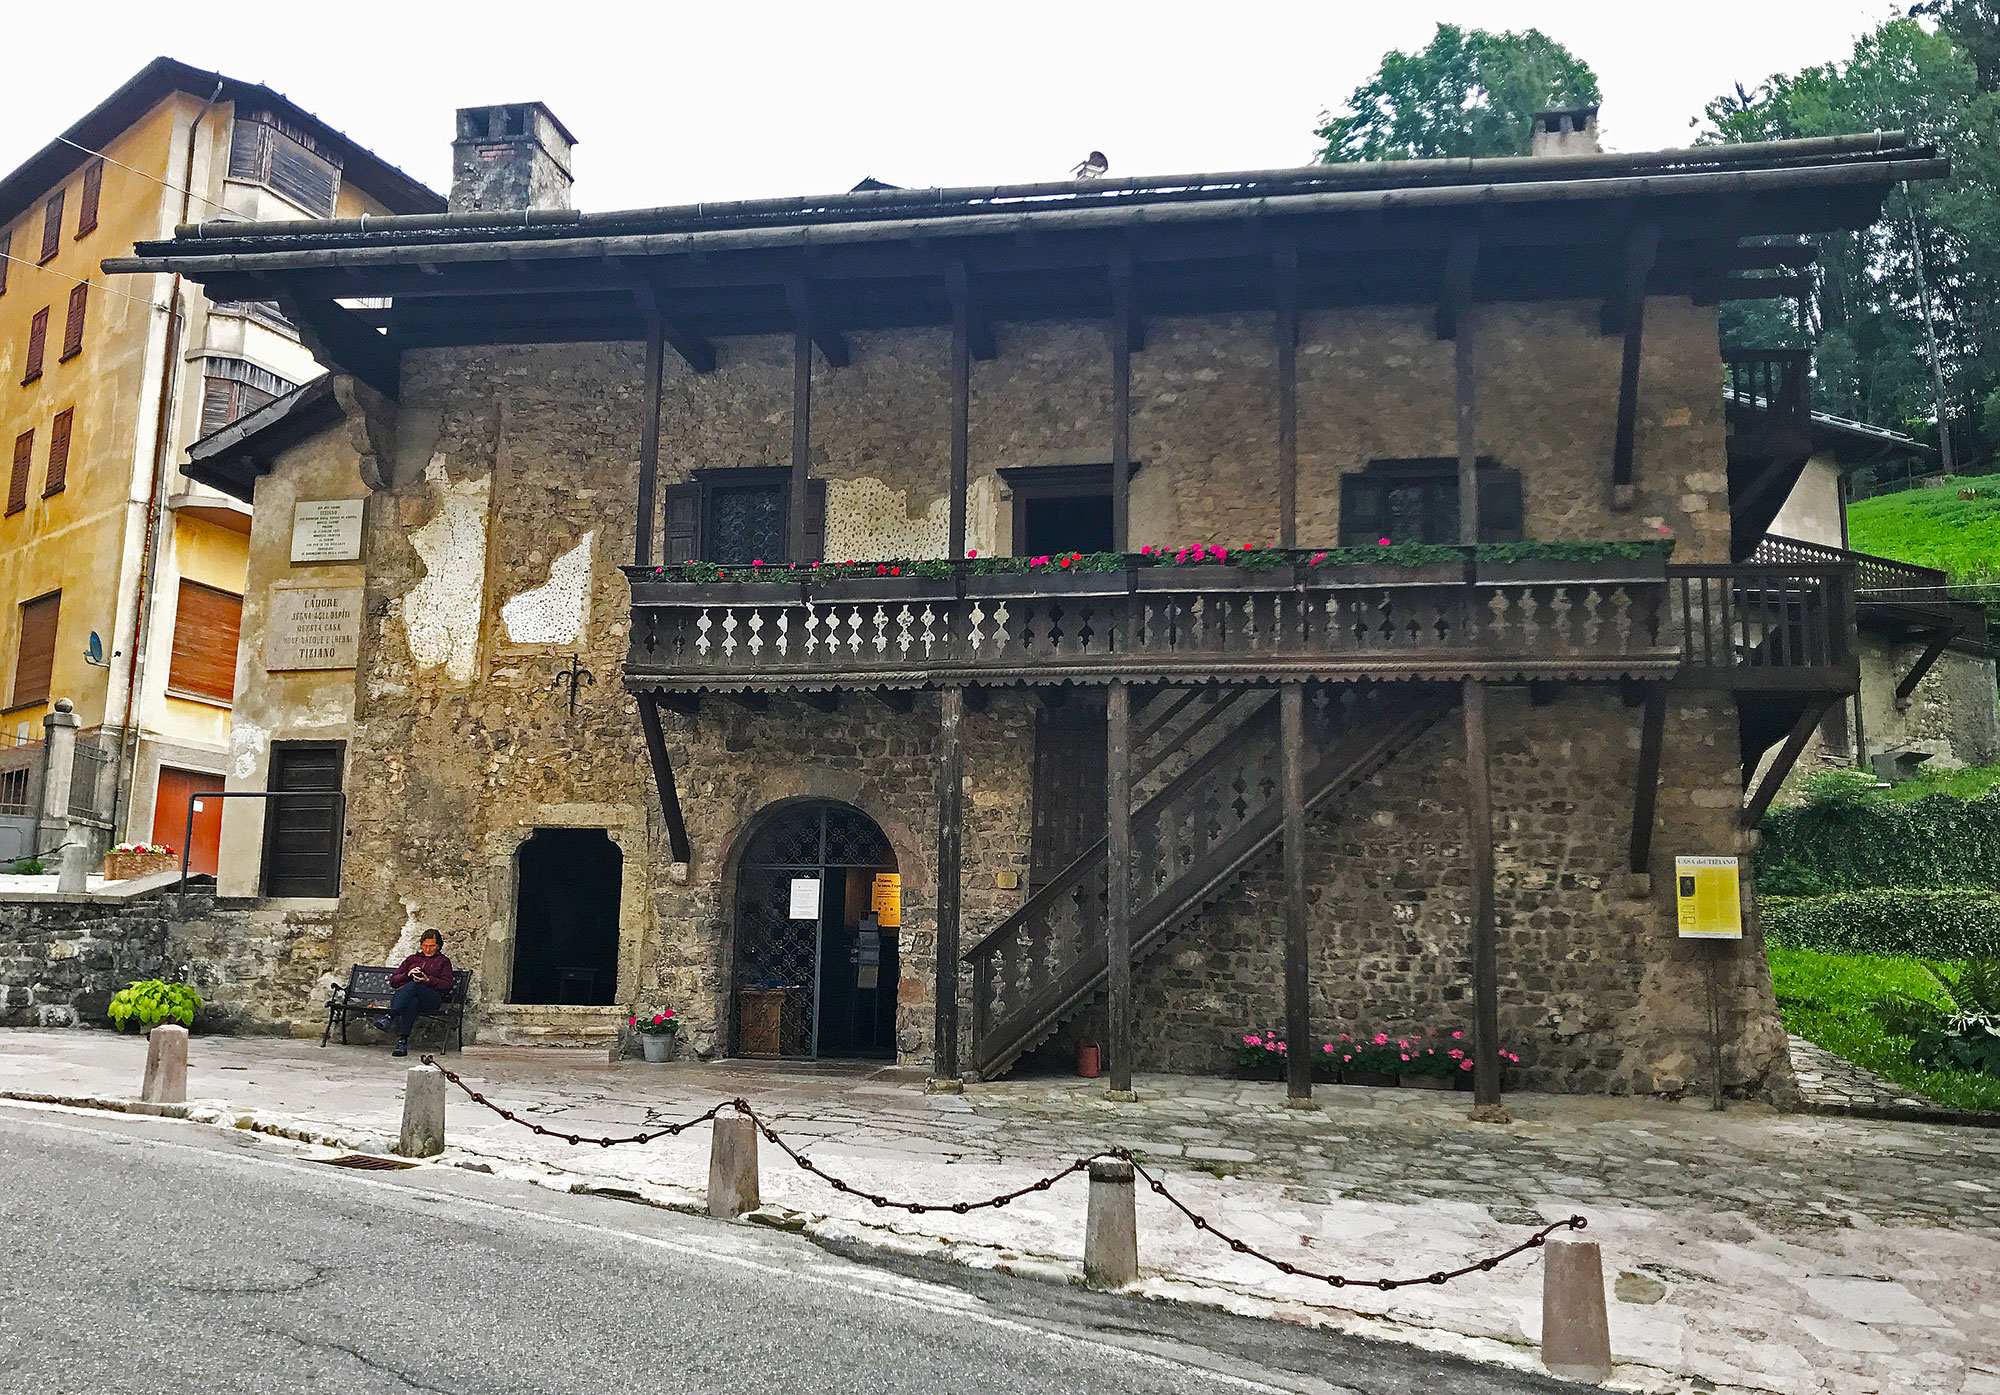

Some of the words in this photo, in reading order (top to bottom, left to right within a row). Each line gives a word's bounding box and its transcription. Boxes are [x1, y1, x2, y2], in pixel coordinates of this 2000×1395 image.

[304, 598, 338, 608] CADORE
[297, 624, 322, 632] QUESTA
[324, 623, 341, 631] CASA
[299, 648, 335, 658] TIZIANO
